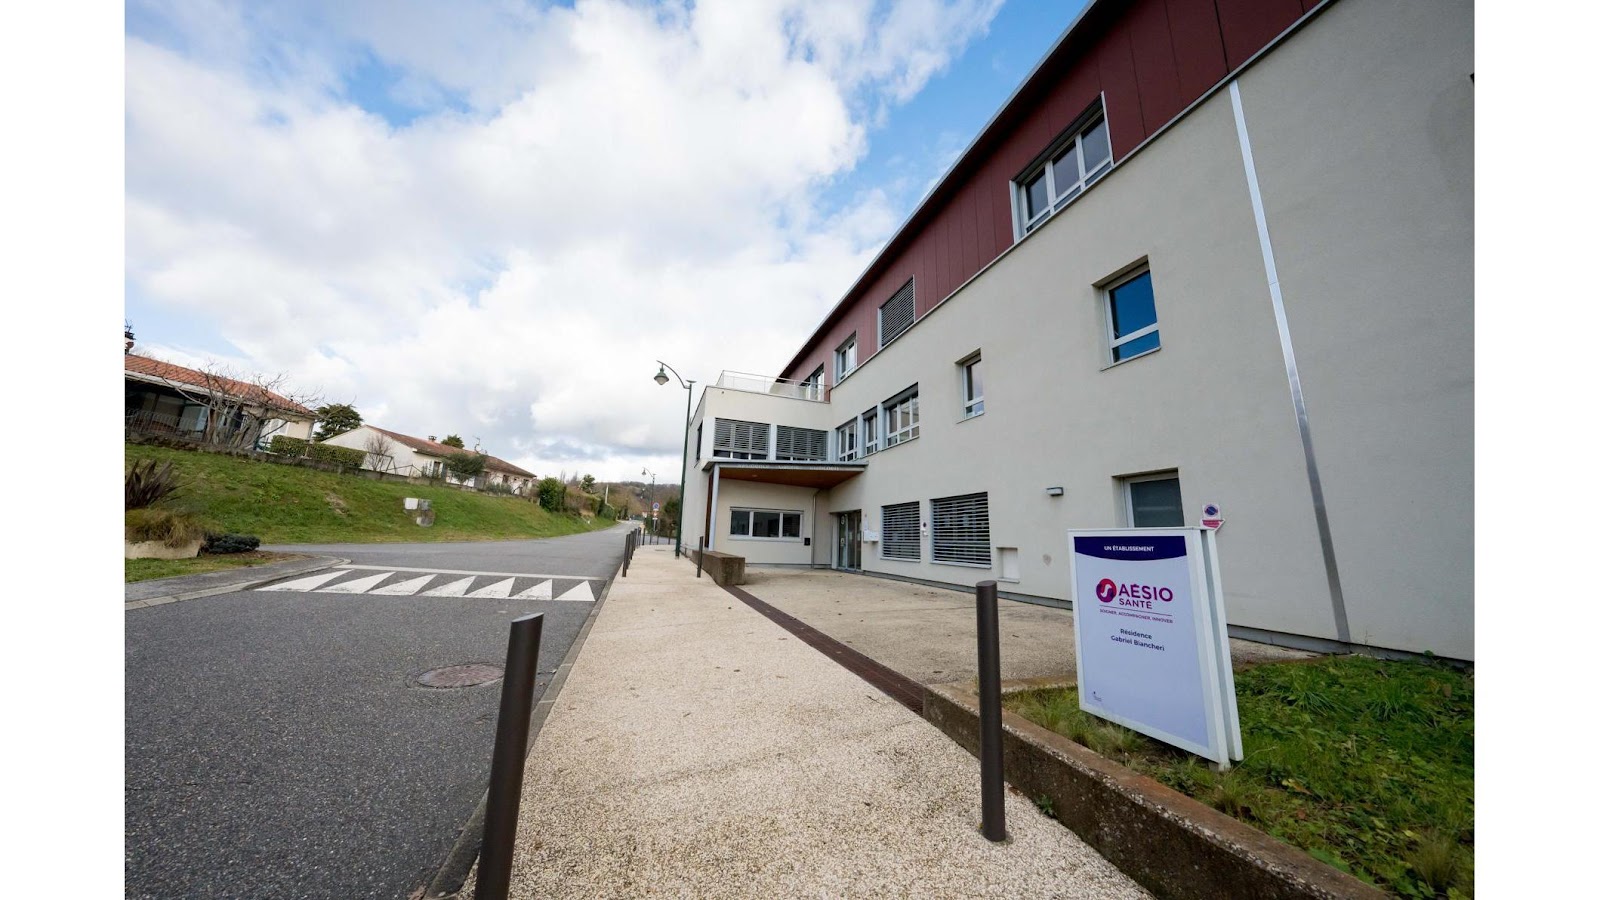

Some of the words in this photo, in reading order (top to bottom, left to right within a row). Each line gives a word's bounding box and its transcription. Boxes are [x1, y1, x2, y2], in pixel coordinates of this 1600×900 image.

[1119, 584, 1173, 602] AÉSIO
[1119, 598, 1152, 609] SANTÉ
[1110, 635, 1133, 645] Gabriel
[1133, 639, 1165, 652] Biancheri
